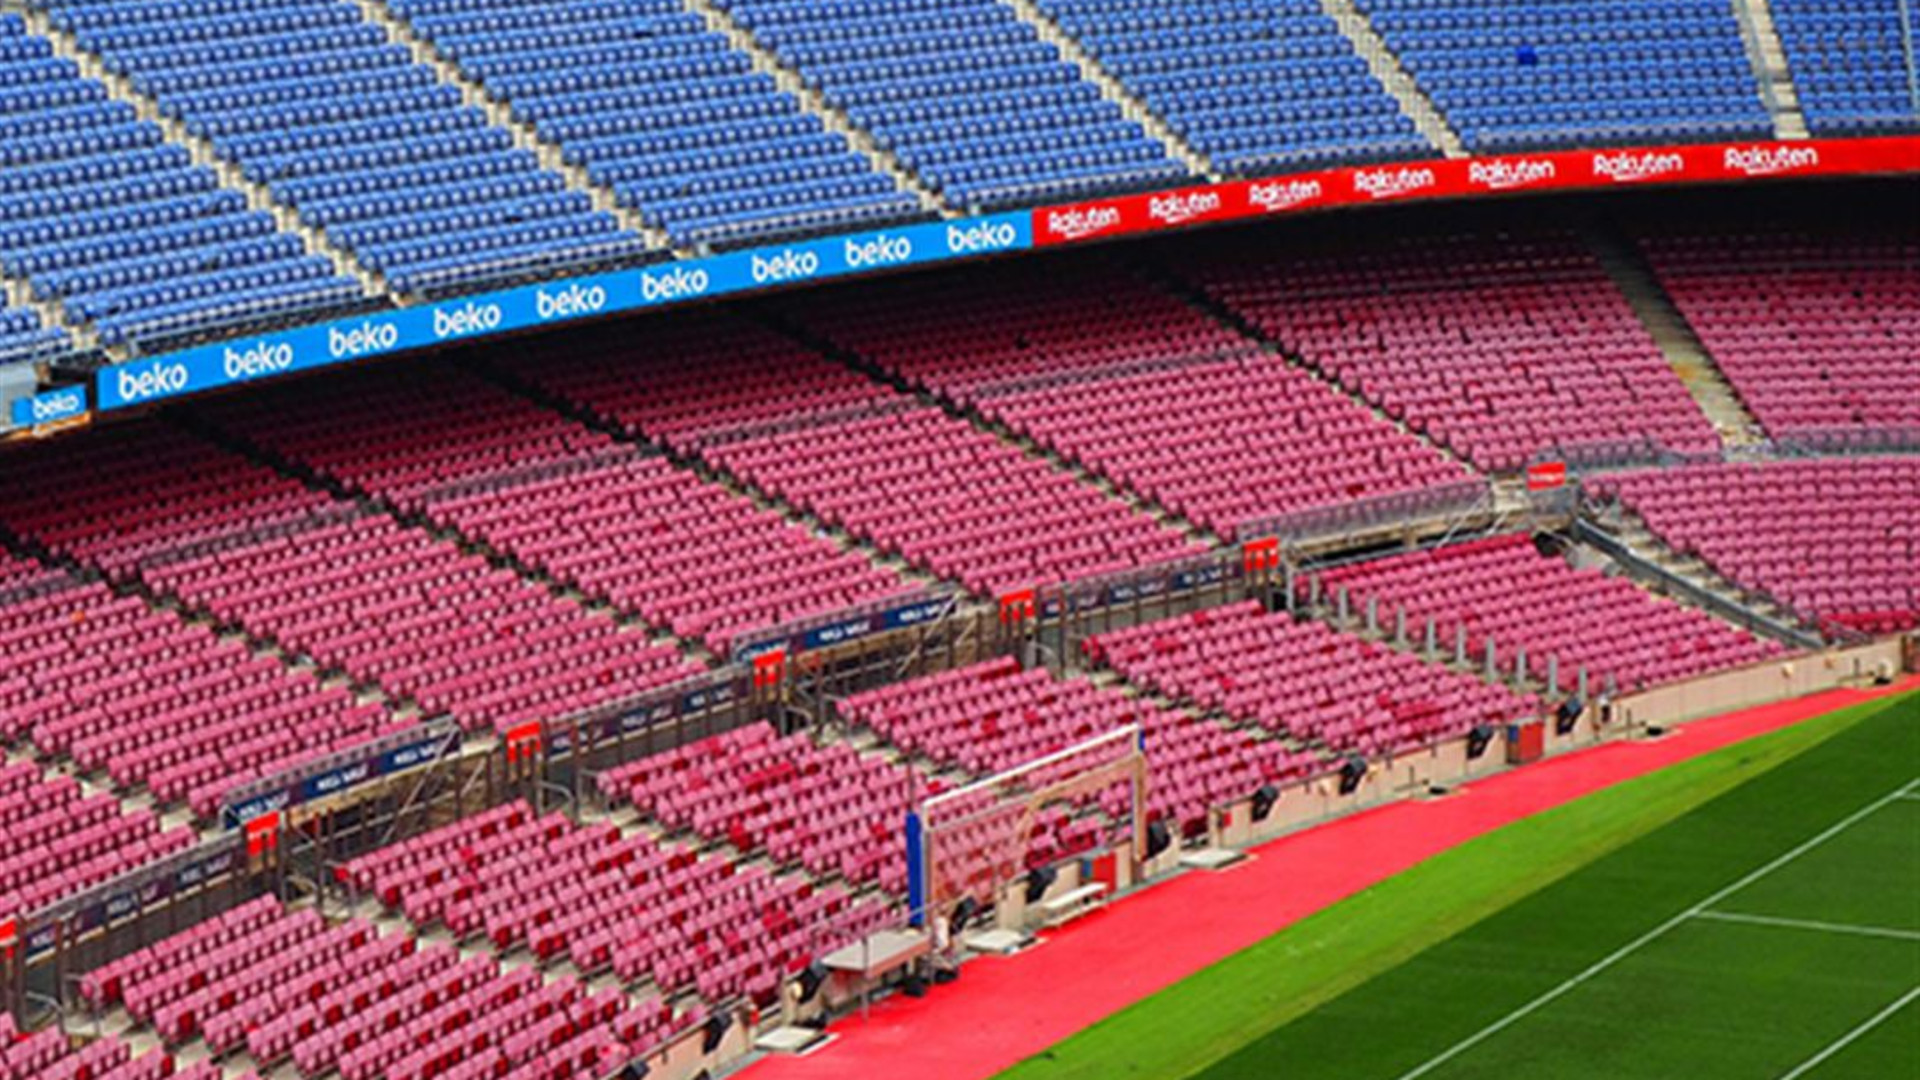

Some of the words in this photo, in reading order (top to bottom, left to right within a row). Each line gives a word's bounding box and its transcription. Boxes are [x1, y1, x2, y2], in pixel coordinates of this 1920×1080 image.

[1250, 180, 1321, 210] Rakuten
[1355, 168, 1434, 197] Rakuten
[1469, 159, 1554, 188] Rakuten
[1594, 152, 1683, 180] Rakuten
[1725, 146, 1817, 174] Rakuten
[118, 362, 187, 400] beko
[225, 341, 293, 378] beko
[330, 321, 398, 357] beko
[434, 303, 501, 337] beko
[536, 284, 606, 318] beko
[641, 267, 709, 301] beko
[751, 249, 819, 282] beko
[845, 235, 912, 267] beko
[946, 220, 1016, 252] beko
[33, 392, 80, 420] beko
